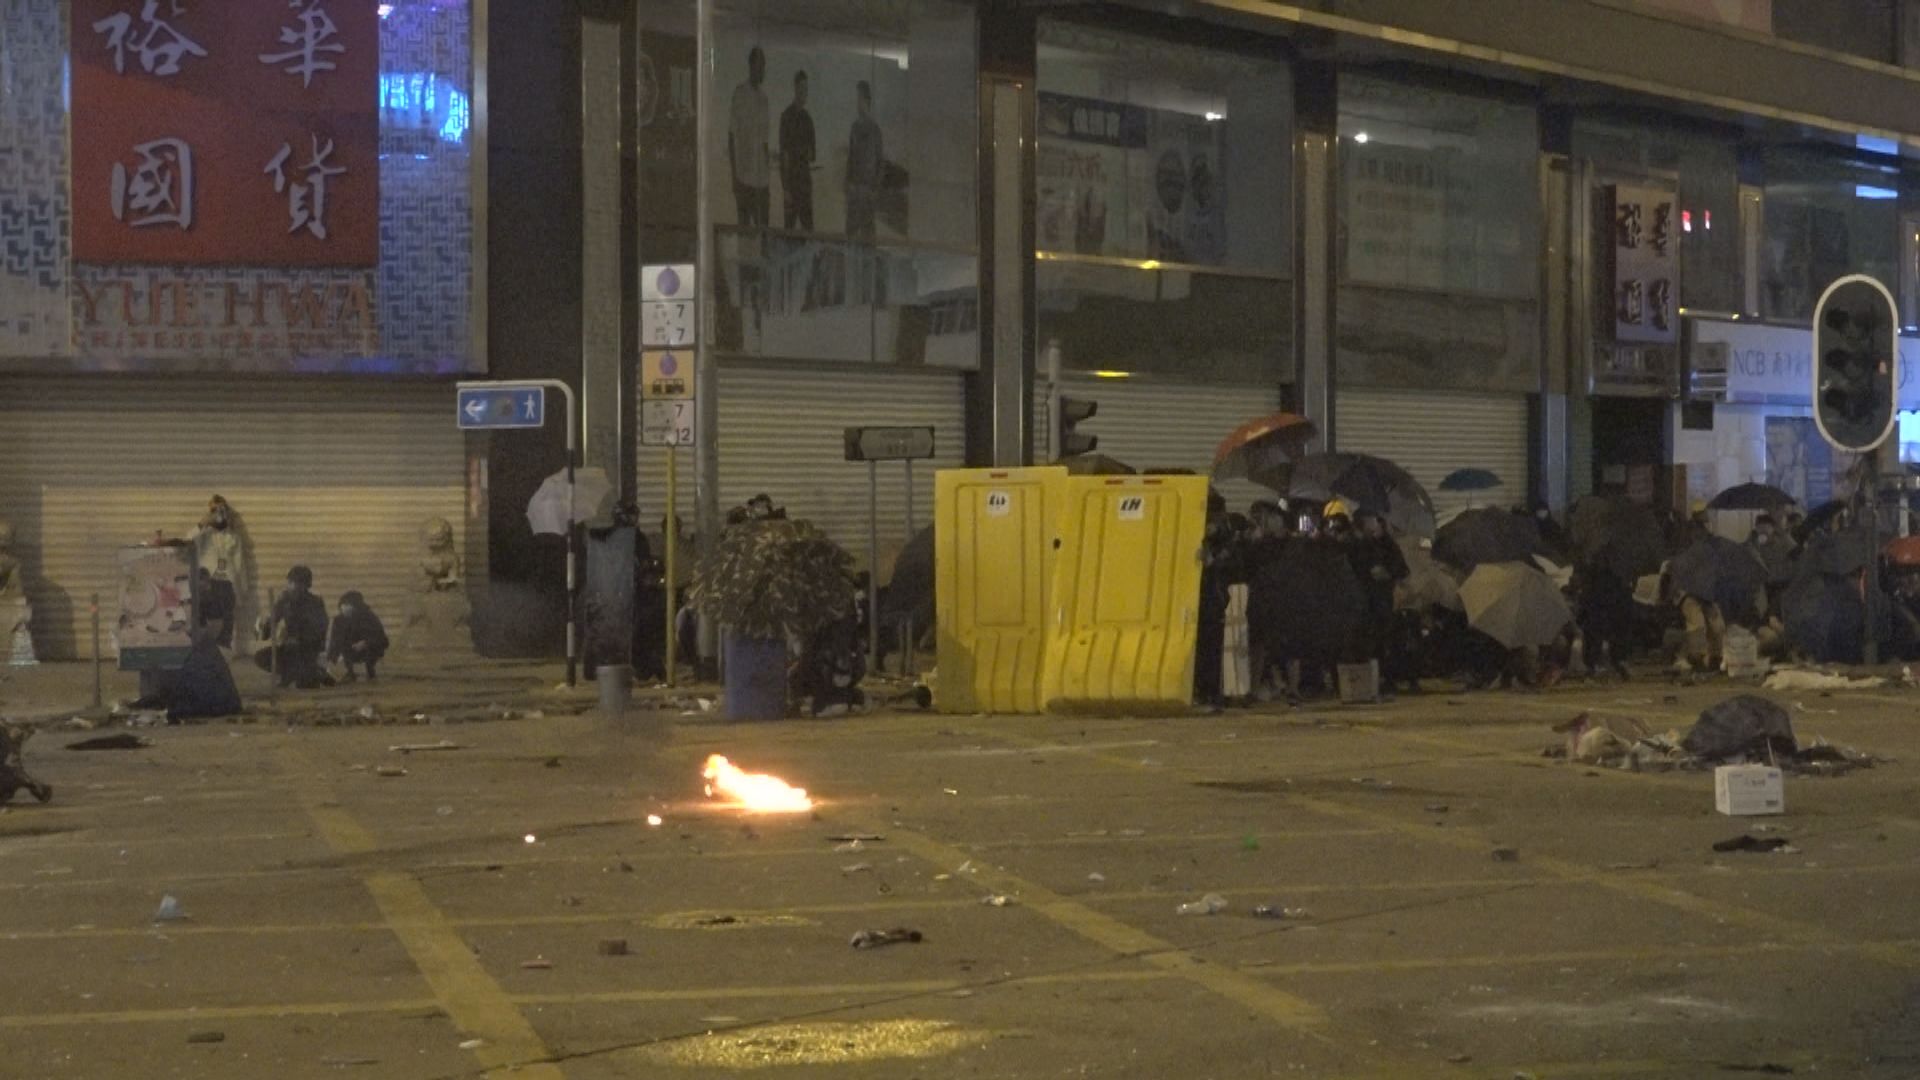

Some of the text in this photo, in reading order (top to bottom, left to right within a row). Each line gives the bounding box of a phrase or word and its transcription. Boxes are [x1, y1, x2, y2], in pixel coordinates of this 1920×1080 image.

[110, 133, 348, 240] 國貨
[676, 304, 685, 319] 7
[675, 328, 686, 342] 7
[1734, 349, 1766, 376] NCB
[675, 404, 684, 417] 7
[676, 427, 690, 442] 12
